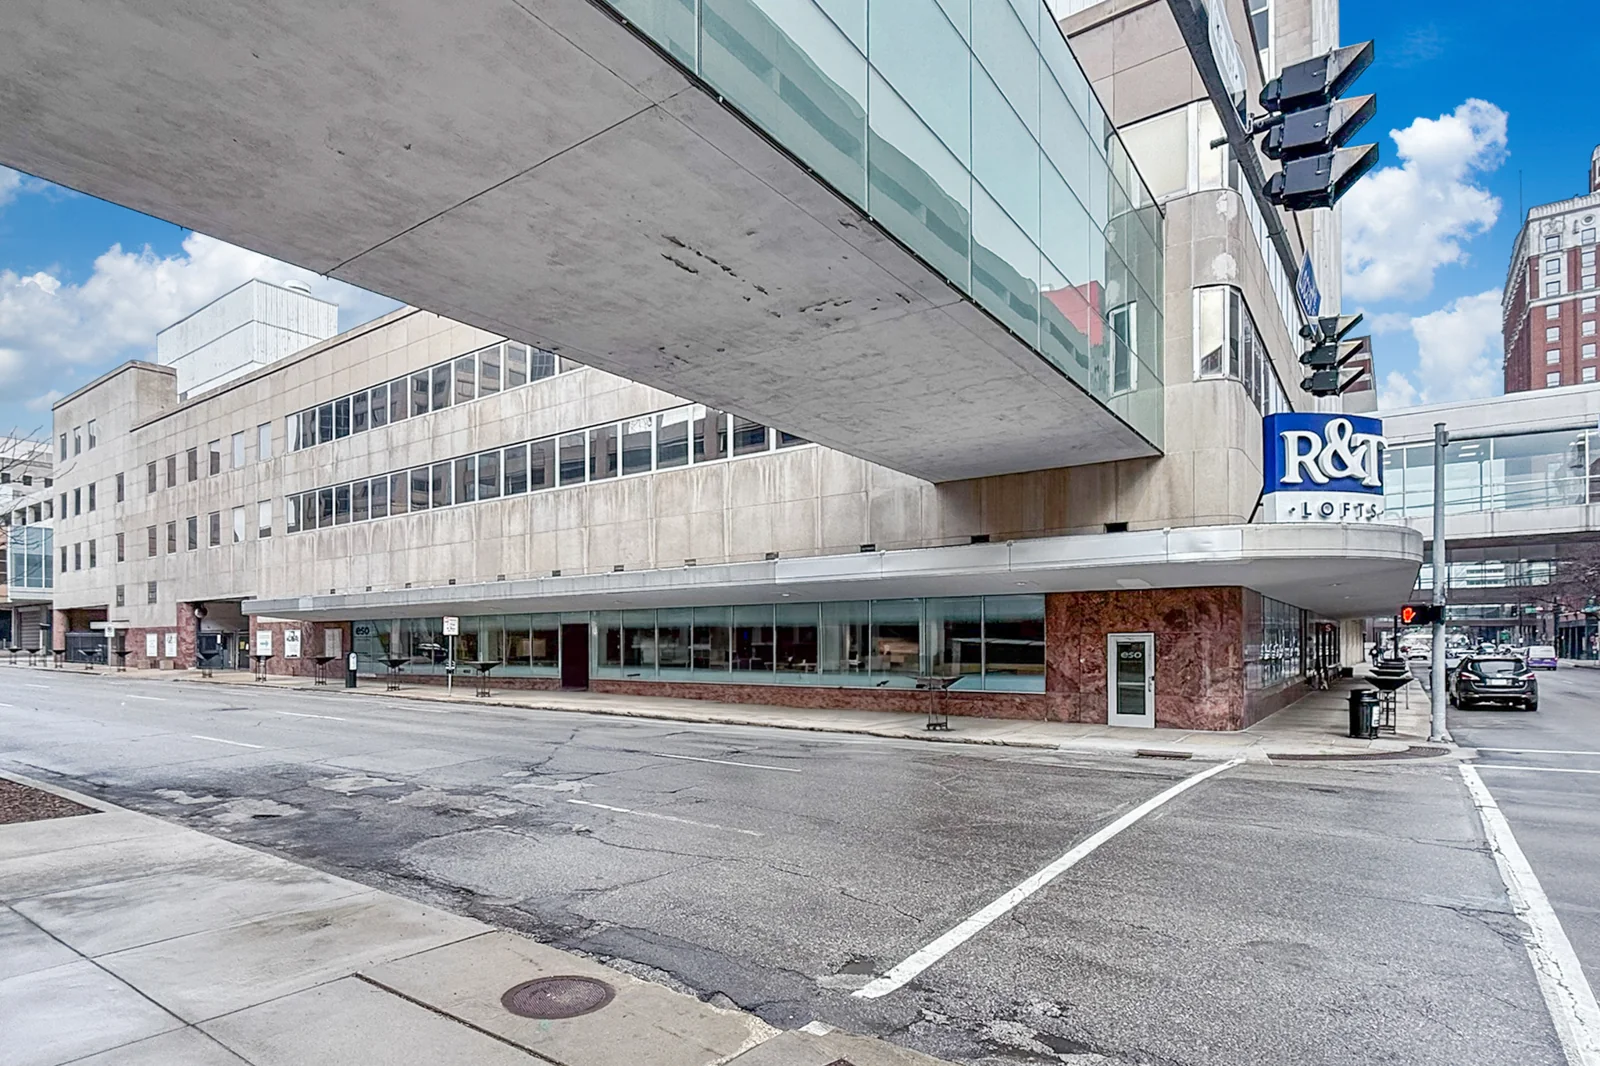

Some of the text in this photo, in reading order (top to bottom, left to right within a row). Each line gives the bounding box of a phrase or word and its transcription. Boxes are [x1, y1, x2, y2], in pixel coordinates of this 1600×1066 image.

[1280, 418, 1388, 487] R&T
[1302, 501, 1377, 520] LOFTS
[1120, 651, 1143, 659] eso
